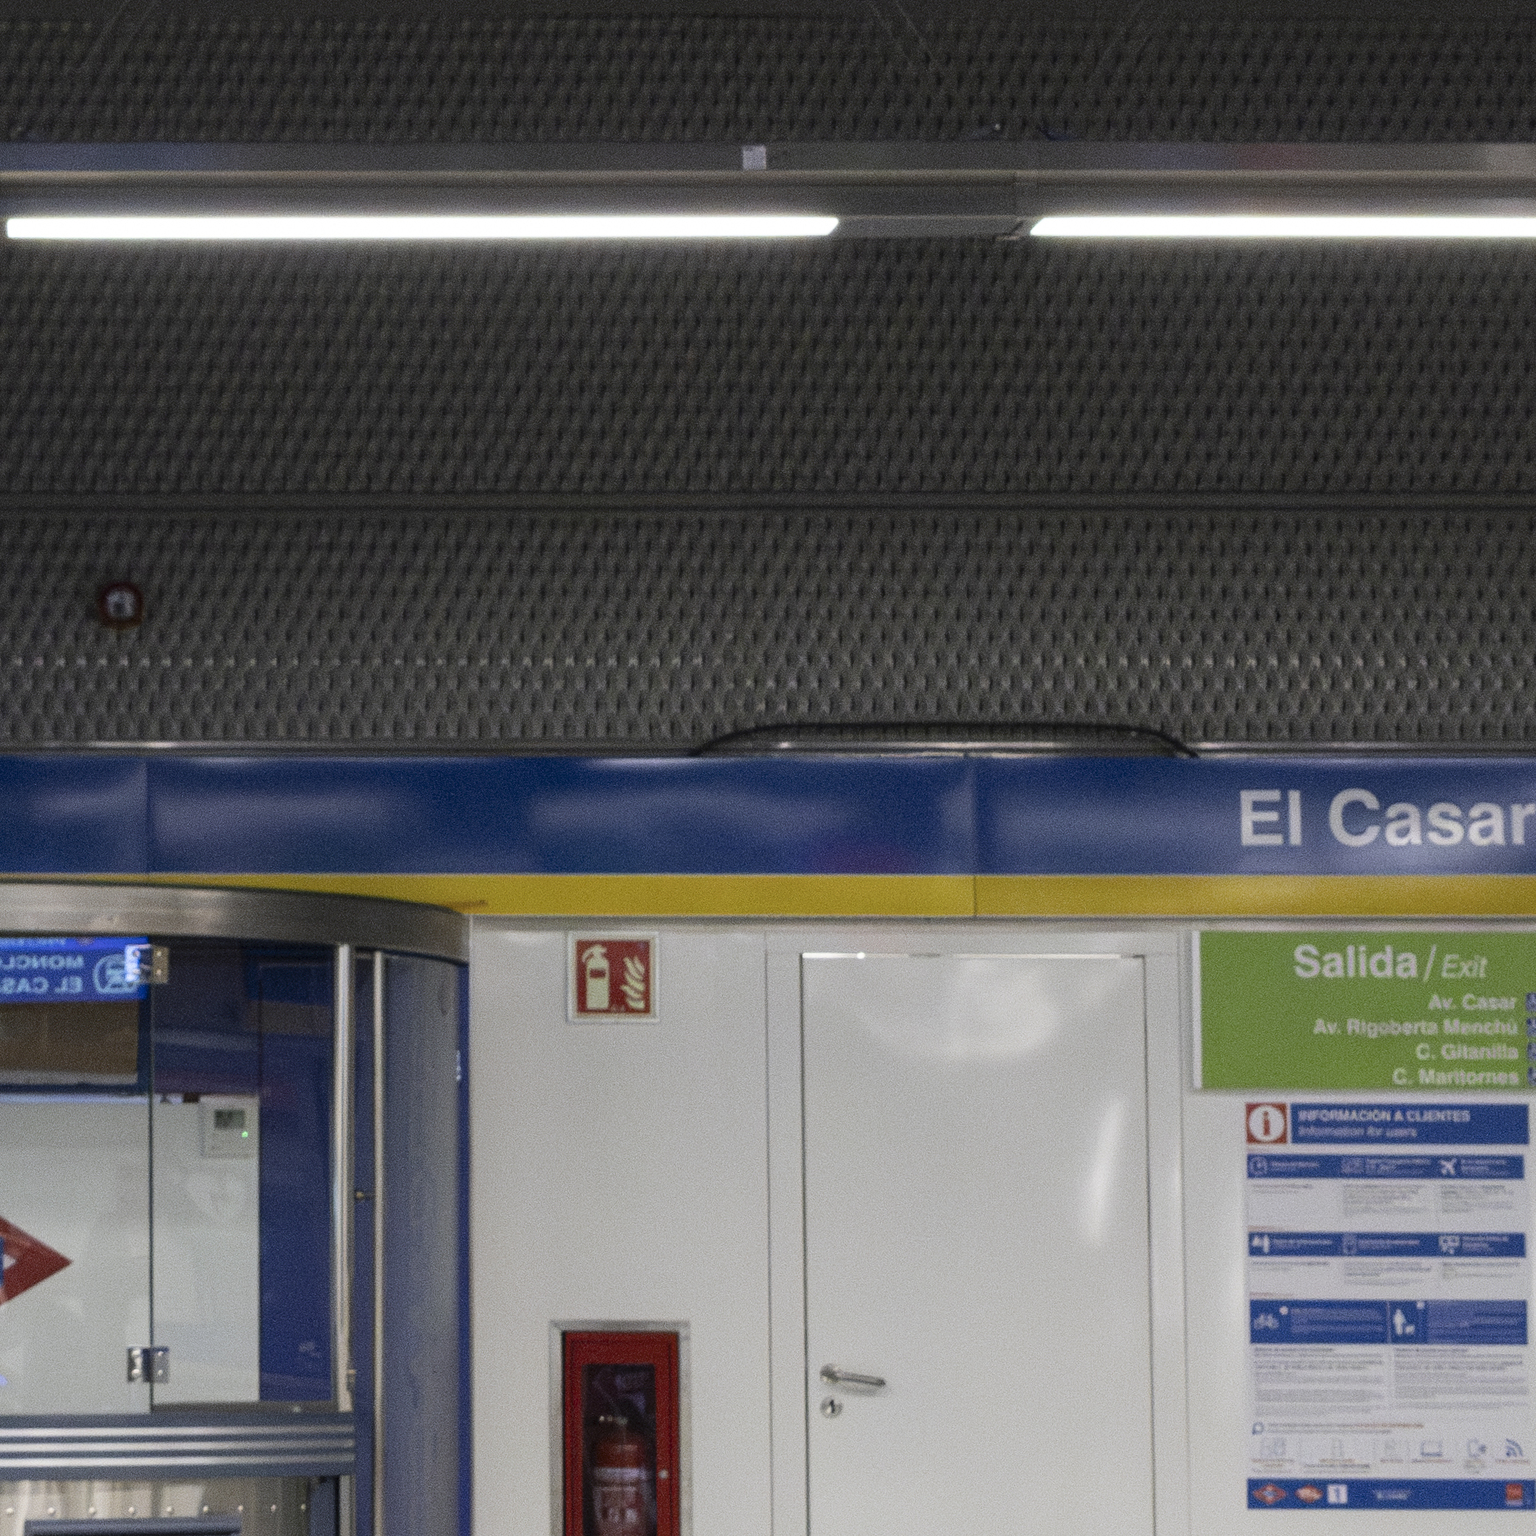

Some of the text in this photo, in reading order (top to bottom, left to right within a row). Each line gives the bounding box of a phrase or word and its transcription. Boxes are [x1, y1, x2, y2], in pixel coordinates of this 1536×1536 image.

[1240, 787, 1536, 847] El Casar
[1293, 943, 1418, 979] Salida
[1440, 953, 1488, 979] Exit
